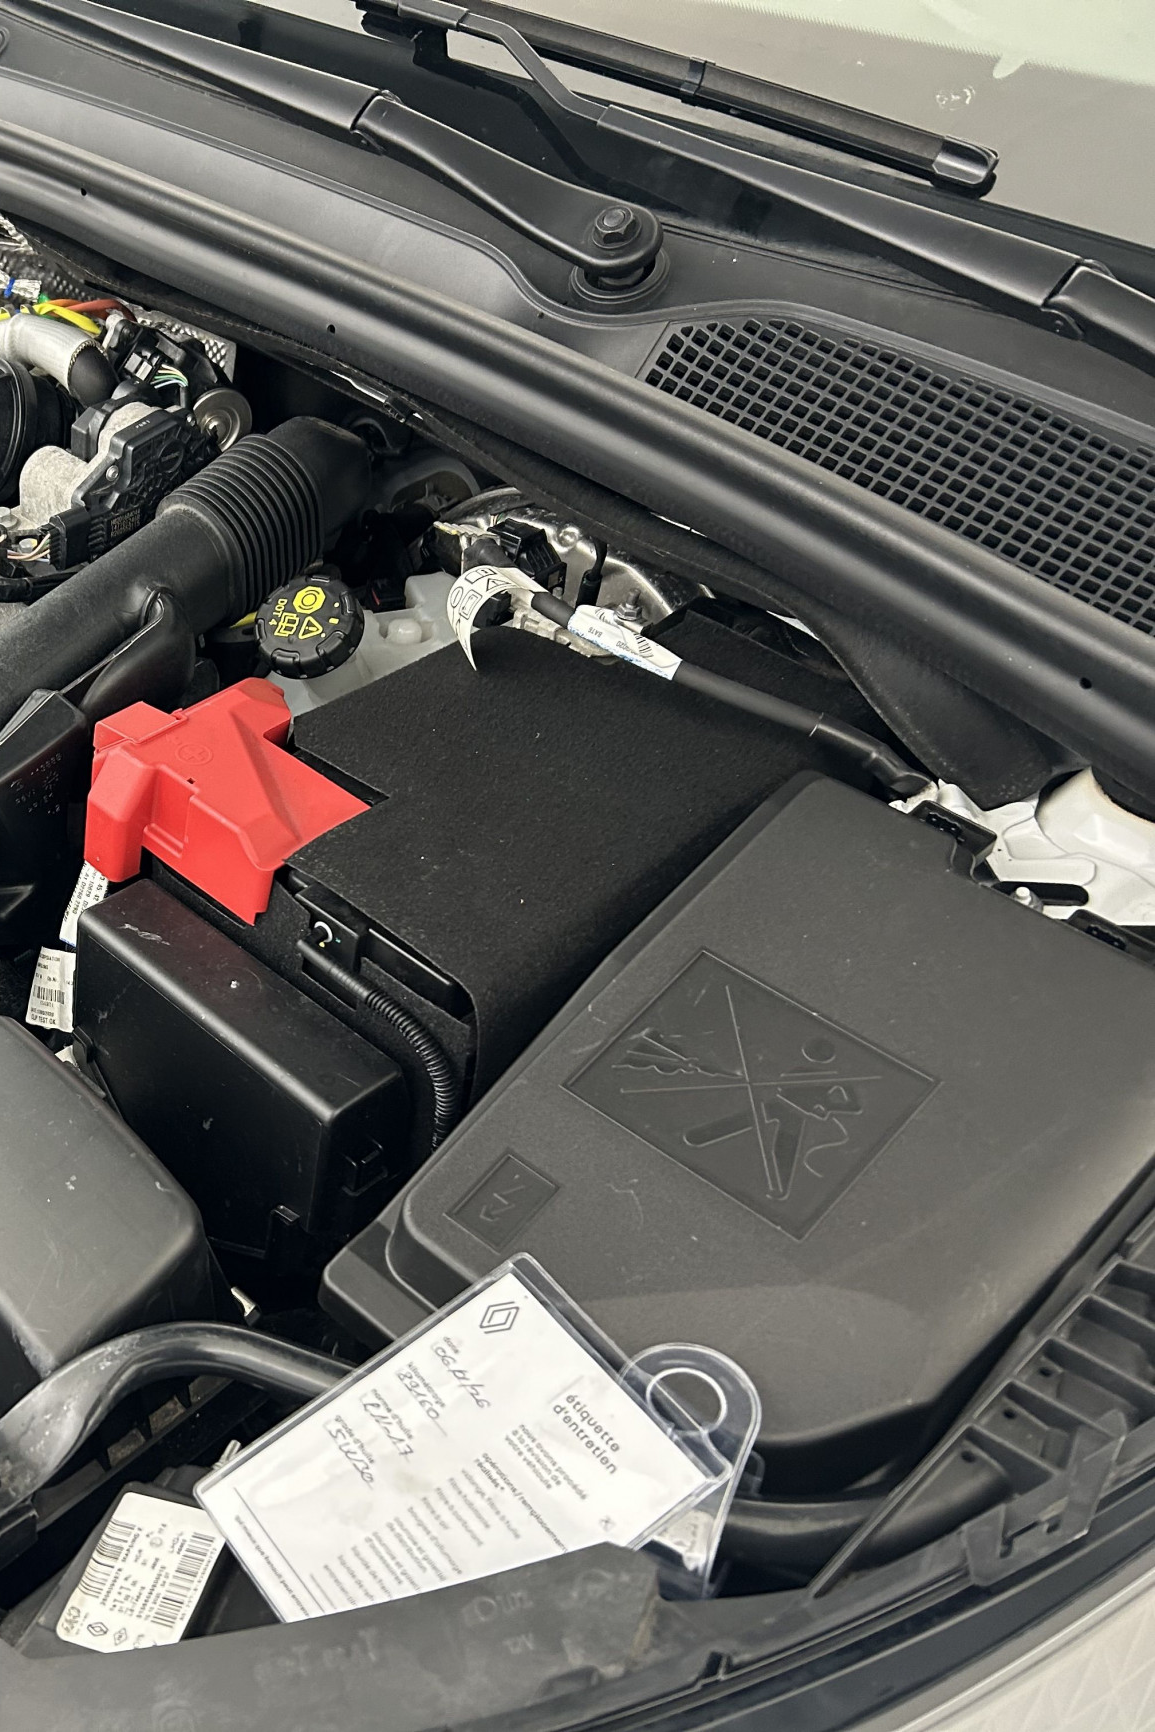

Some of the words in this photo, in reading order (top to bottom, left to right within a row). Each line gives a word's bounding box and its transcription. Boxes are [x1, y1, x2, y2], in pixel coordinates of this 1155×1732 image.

[272, 598, 288, 617] DOT
[443, 1336, 460, 1354] date
[407, 1361, 446, 1408] kilométrage
[334, 1414, 355, 1438] grade
[353, 1438, 376, 1464] d'huile
[371, 1388, 392, 1413] norme
[390, 1413, 414, 1440] d'huile
[552, 1404, 617, 1474] d'entretien
[565, 1394, 620, 1452] étiquette
[504, 1434, 524, 1457] votre
[522, 1456, 552, 1490] véhicule
[518, 1424, 537, 1443] nous
[535, 1442, 557, 1467] avons
[554, 1466, 588, 1500] procédé
[523, 1443, 552, 1475] révision
[550, 1474, 562, 1486] de
